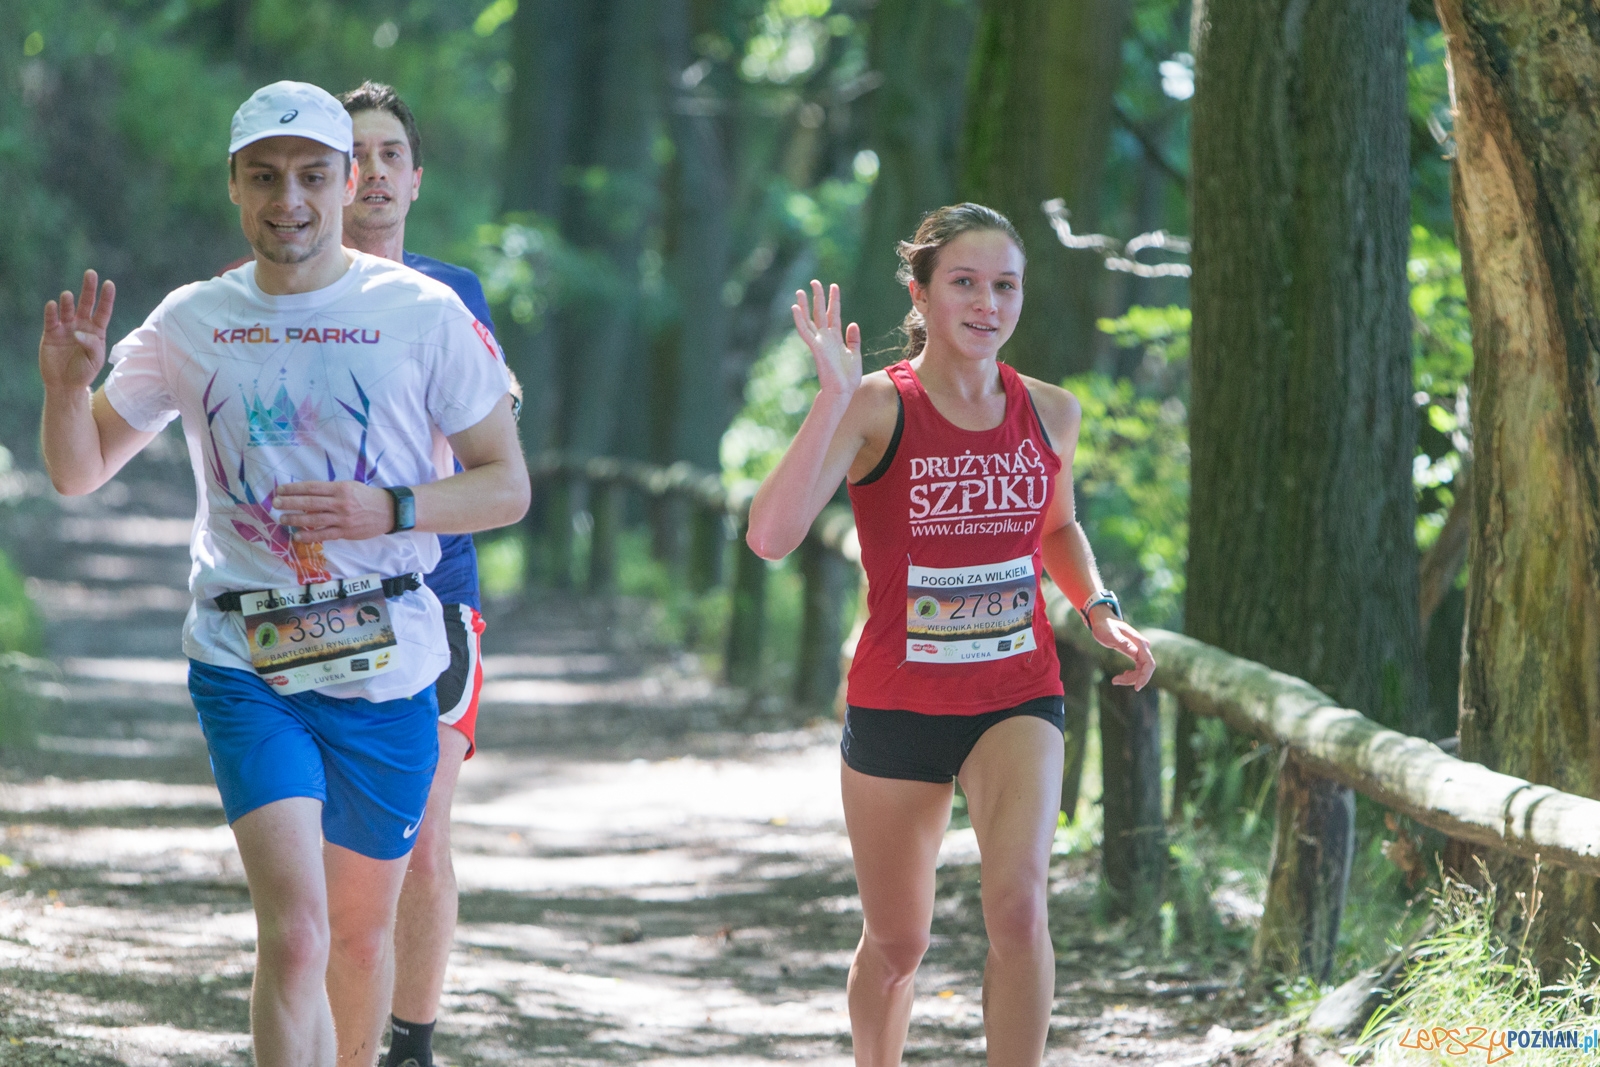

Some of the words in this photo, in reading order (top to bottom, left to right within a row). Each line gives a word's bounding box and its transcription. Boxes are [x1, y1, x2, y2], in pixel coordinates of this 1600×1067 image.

[213, 322, 279, 344] KRÓL
[285, 327, 381, 344] PARKU
[909, 449, 1028, 480] DRUŻYNA
[909, 475, 1049, 519] SZPIKU
[911, 518, 1036, 538] www.darszpiku.pl
[921, 573, 964, 586] POGOŃ
[967, 574, 983, 584] ZA
[985, 565, 1028, 581] WILKIEM
[949, 591, 1003, 620] 278
[286, 607, 346, 643] 336
[927, 623, 972, 632] WERONIKA
[270, 644, 325, 662] BARTŁOMIEJ
[326, 633, 374, 650] RYNIEWICZ
[961, 651, 991, 660] LUVENA
[314, 672, 346, 684] LUVENA
